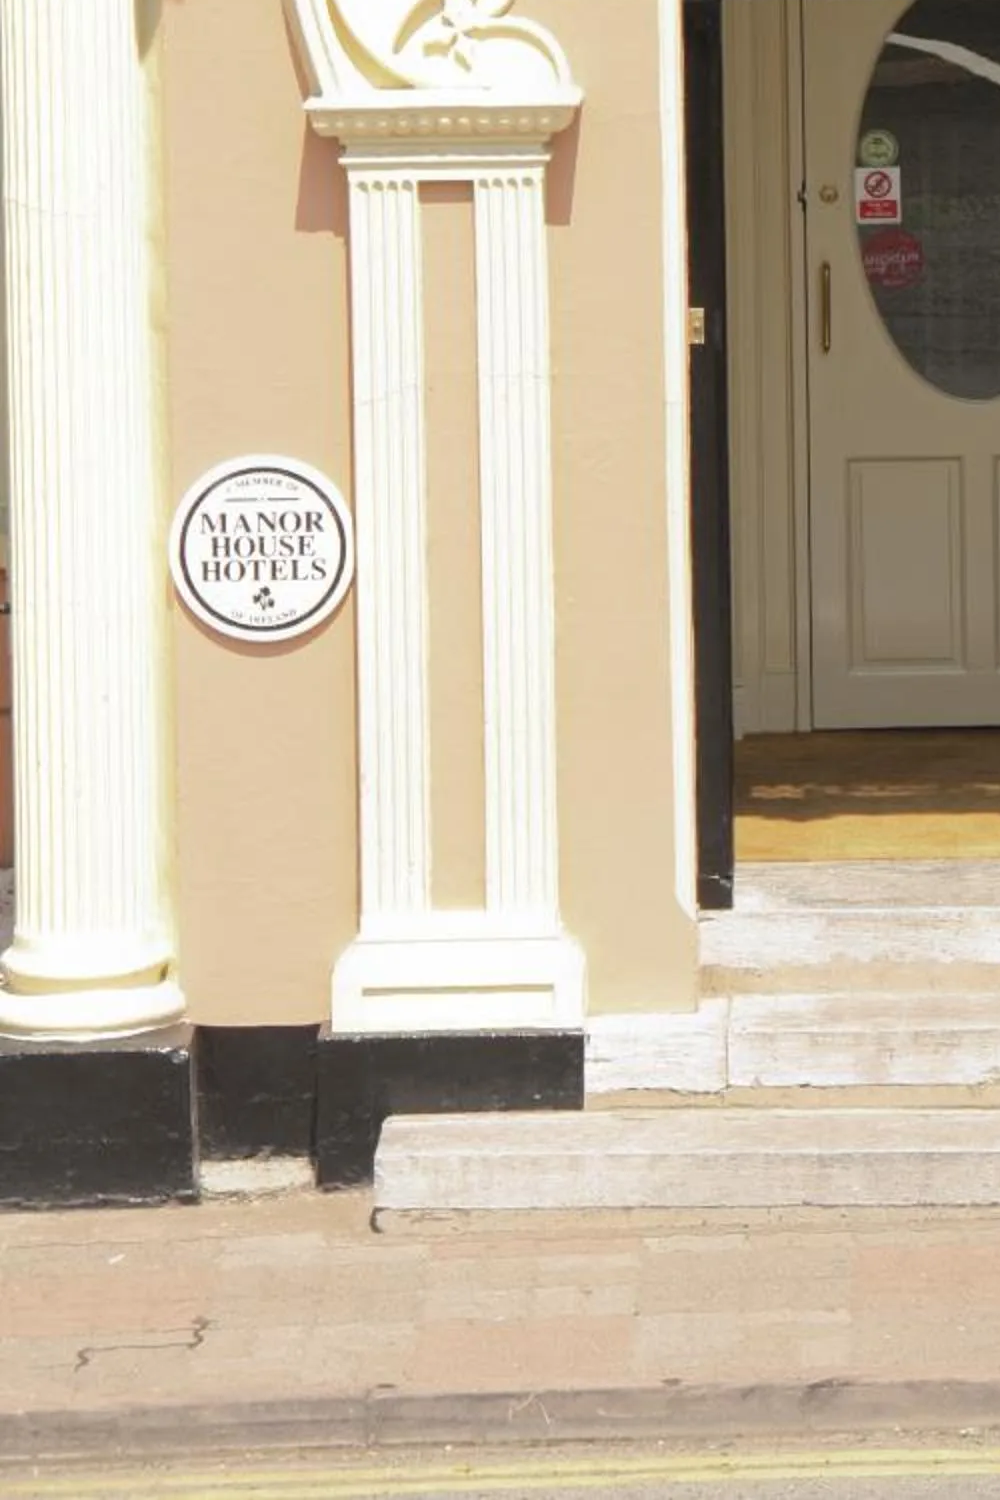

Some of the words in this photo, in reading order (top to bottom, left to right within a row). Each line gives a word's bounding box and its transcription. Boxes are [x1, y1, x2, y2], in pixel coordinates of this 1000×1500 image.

[200, 510, 324, 534] MANOR
[211, 535, 316, 558] HOUSE
[201, 558, 327, 582] HOTELS
